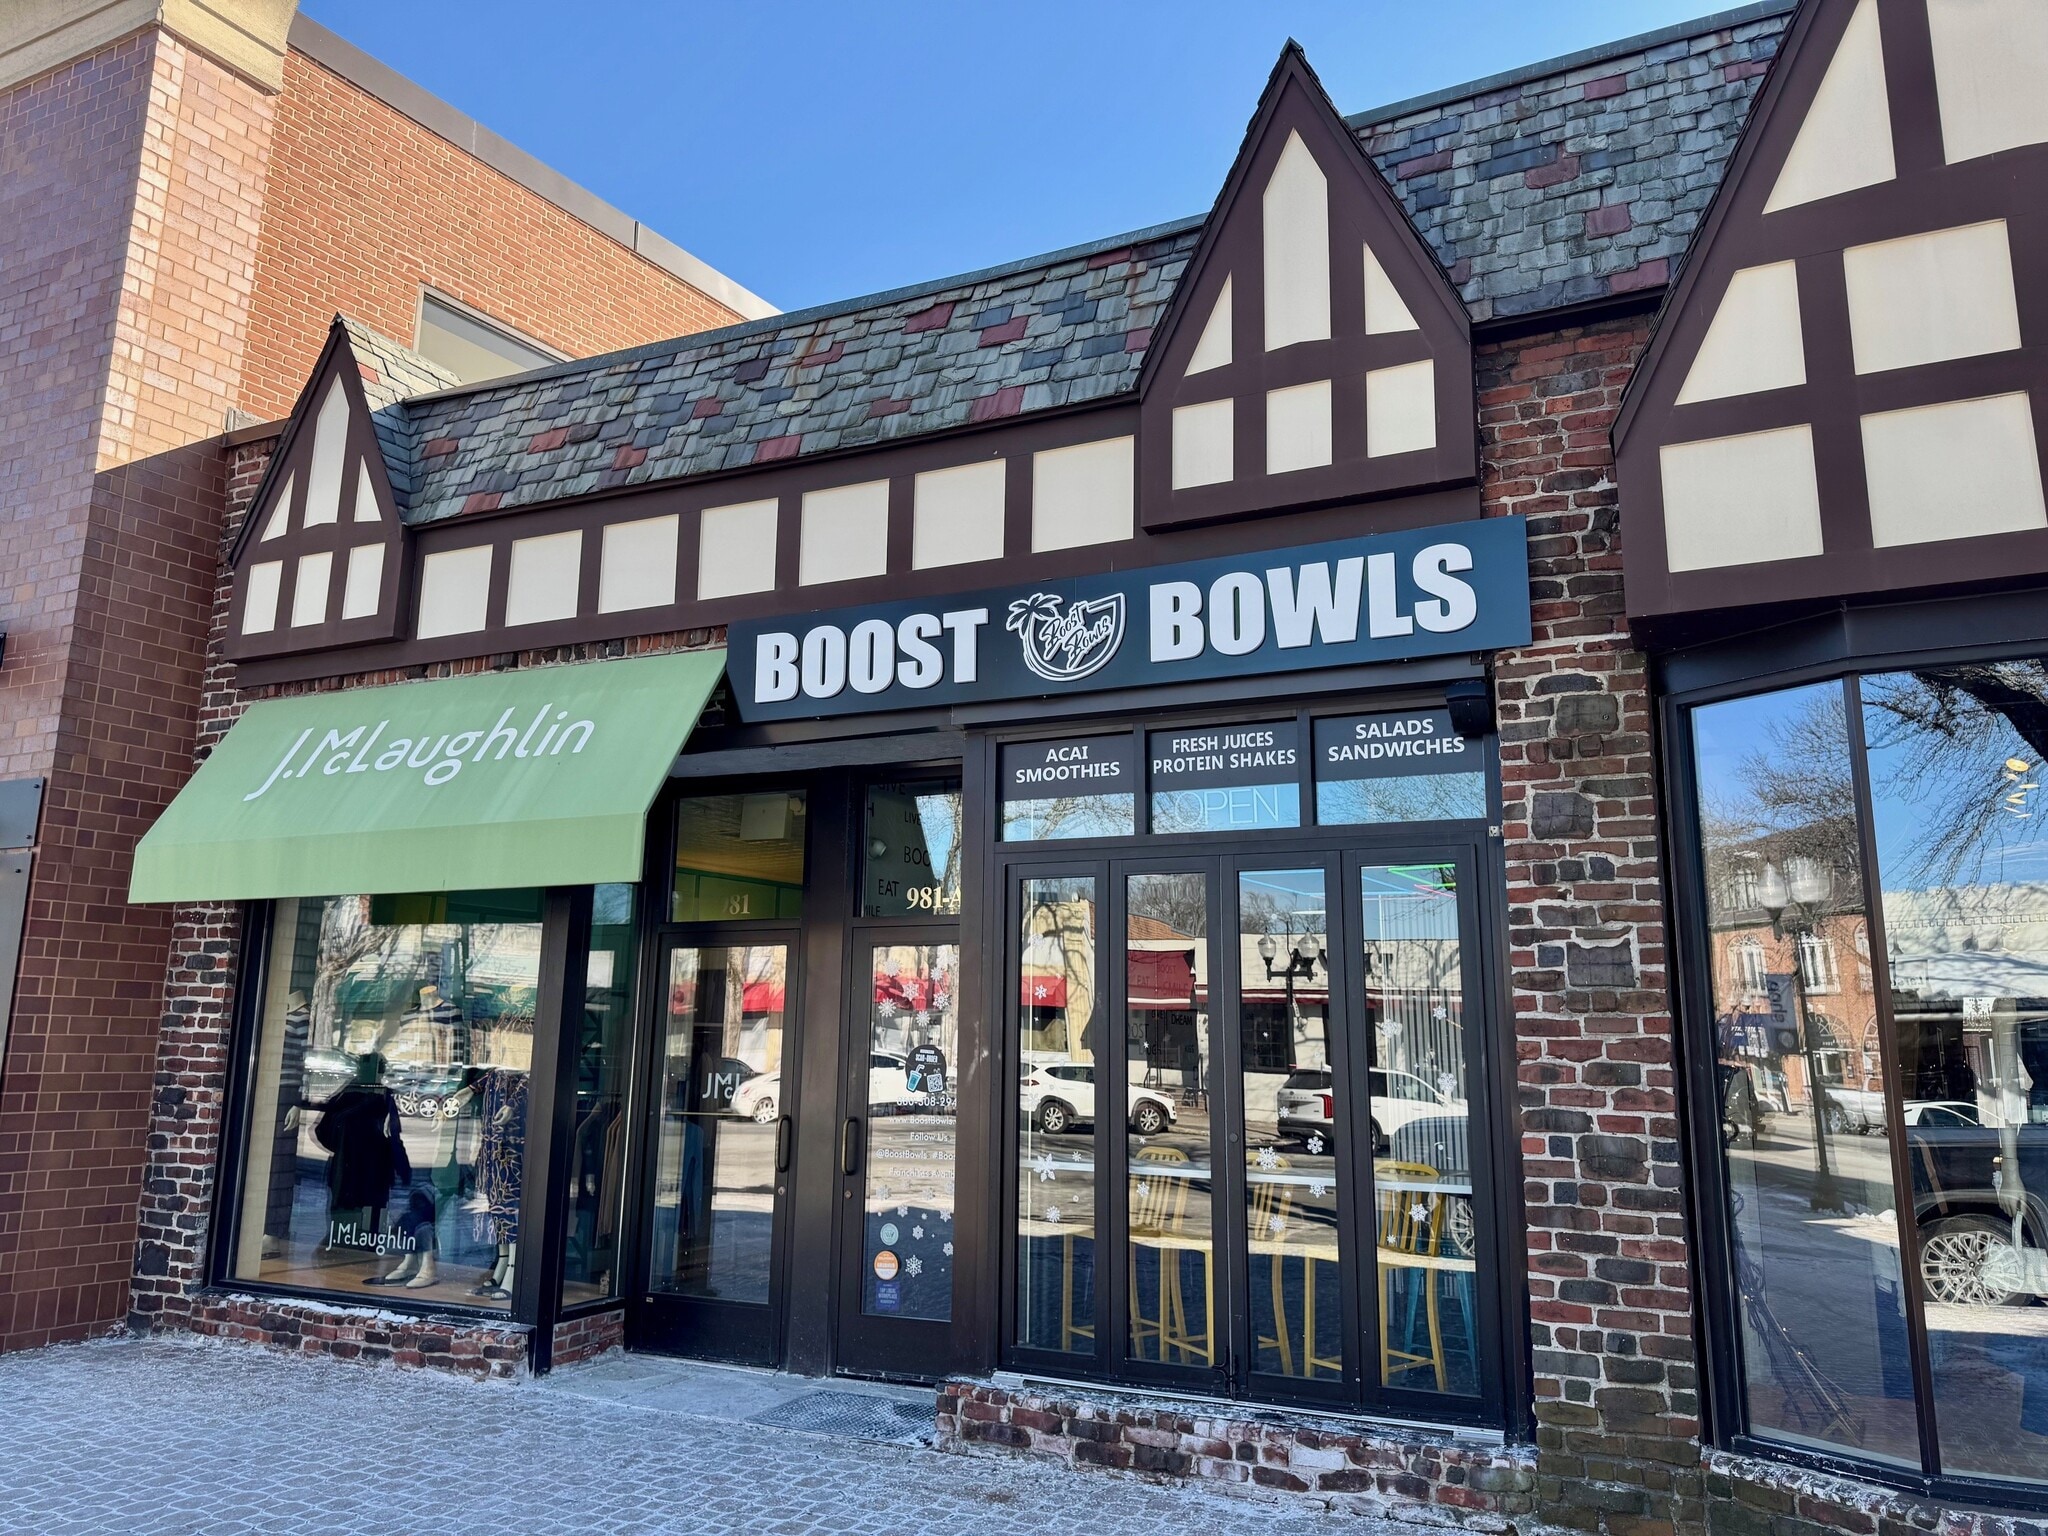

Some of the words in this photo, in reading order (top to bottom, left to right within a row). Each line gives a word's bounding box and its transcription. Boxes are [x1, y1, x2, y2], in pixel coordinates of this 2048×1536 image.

[755, 608, 989, 704] BOOST
[1149, 542, 1478, 663] BOWLS
[1039, 600, 1086, 661] Boost
[1061, 614, 1113, 671] Bowls
[1355, 718, 1434, 740] SALADS
[242, 702, 596, 801] J.McLaughlin
[1045, 745, 1089, 763] ACAI
[1172, 735, 1219, 754] FRESH
[1222, 731, 1274, 750] JUICES
[1328, 736, 1466, 762] SANDWICHES
[1015, 761, 1121, 783] SMOOTHIES
[1153, 754, 1224, 774] PROTEIN
[1229, 749, 1296, 769] SHAKES
[1173, 785, 1280, 828] OPEN
[878, 879, 900, 897] EAT
[910, 1131, 936, 1141] Follow
[325, 1220, 416, 1256] J.McLaughlin
